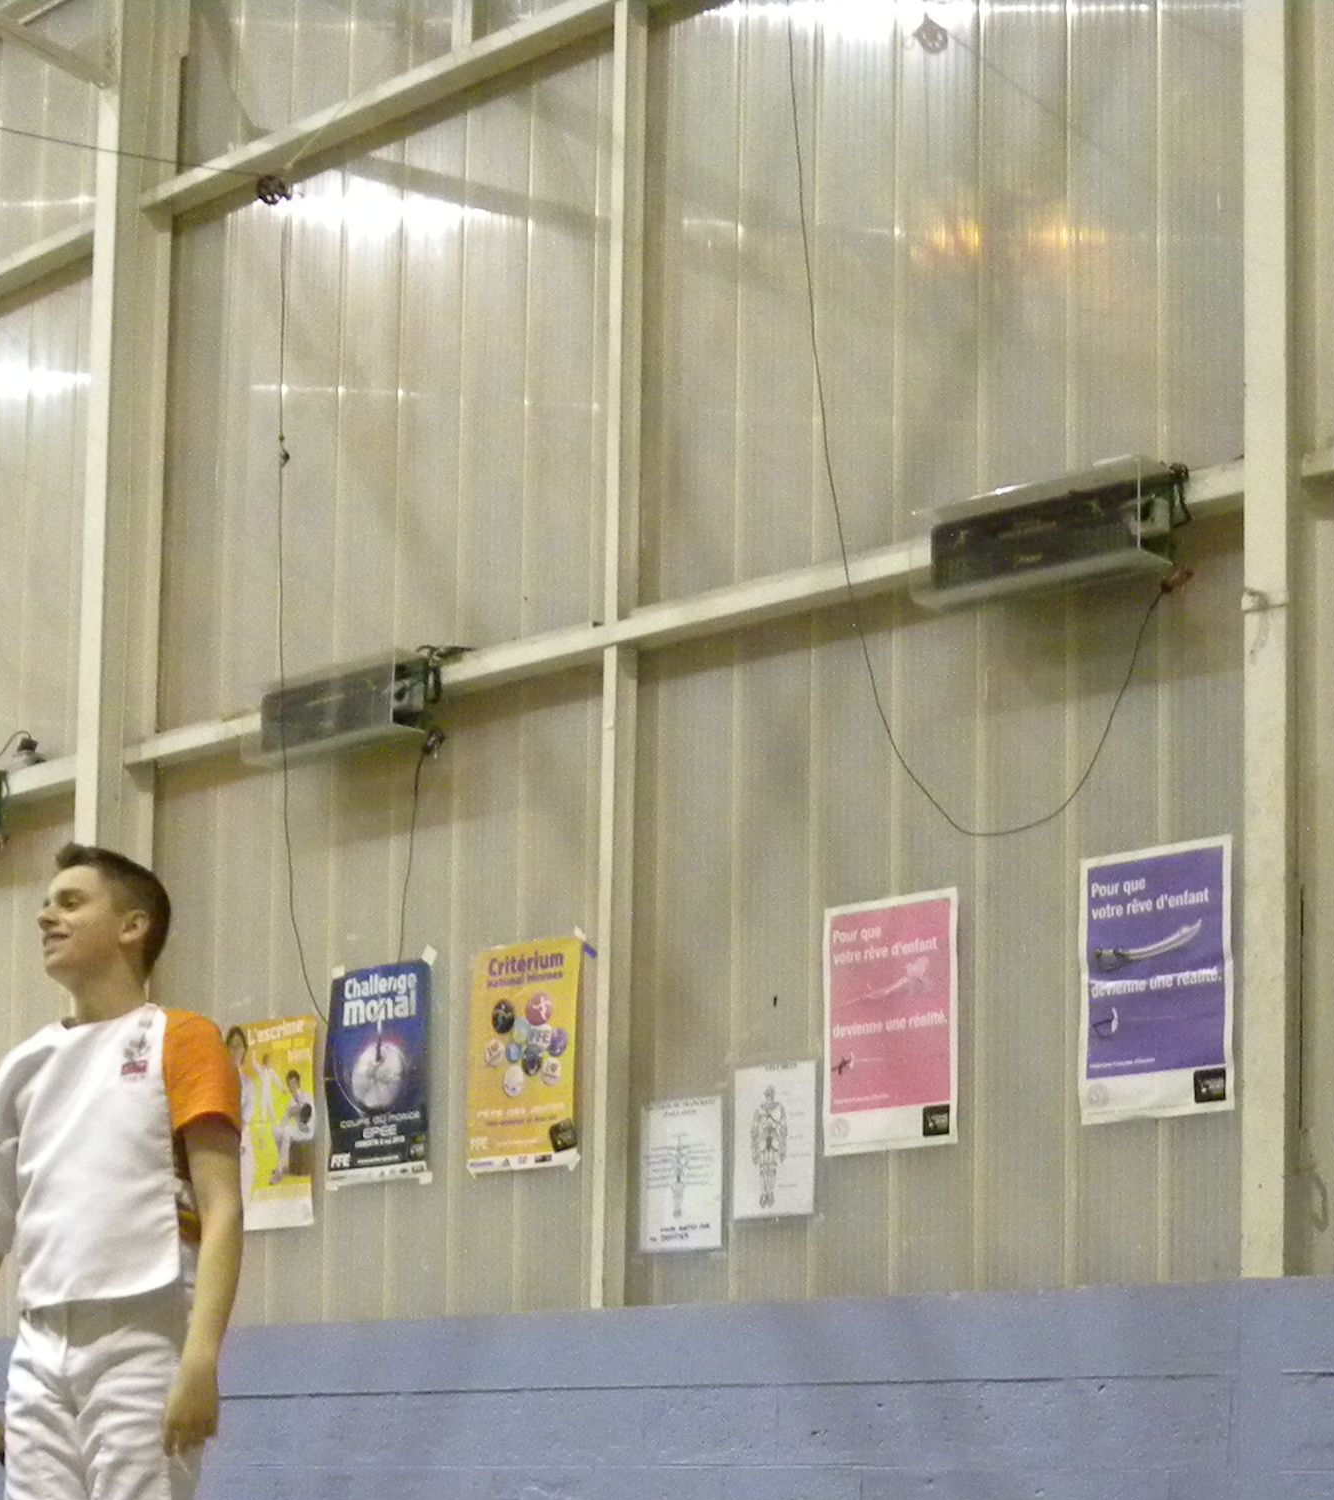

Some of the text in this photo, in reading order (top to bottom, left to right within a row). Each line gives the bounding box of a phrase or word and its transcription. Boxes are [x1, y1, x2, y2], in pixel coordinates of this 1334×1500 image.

[1090, 877, 1146, 898] Pour que
[1091, 887, 1210, 920] votre rêve d'enfant
[832, 926, 882, 943] Pour que
[833, 936, 938, 965] votre rêve d'enfant
[488, 950, 564, 978] Critérium
[344, 972, 418, 1000] Challenge
[1090, 979, 1146, 998] devienne
[1149, 974, 1174, 990] une
[342, 988, 417, 1027] monal
[832, 1020, 884, 1038] devienne
[885, 1017, 907, 1032] une
[330, 1151, 352, 1169] FFE
